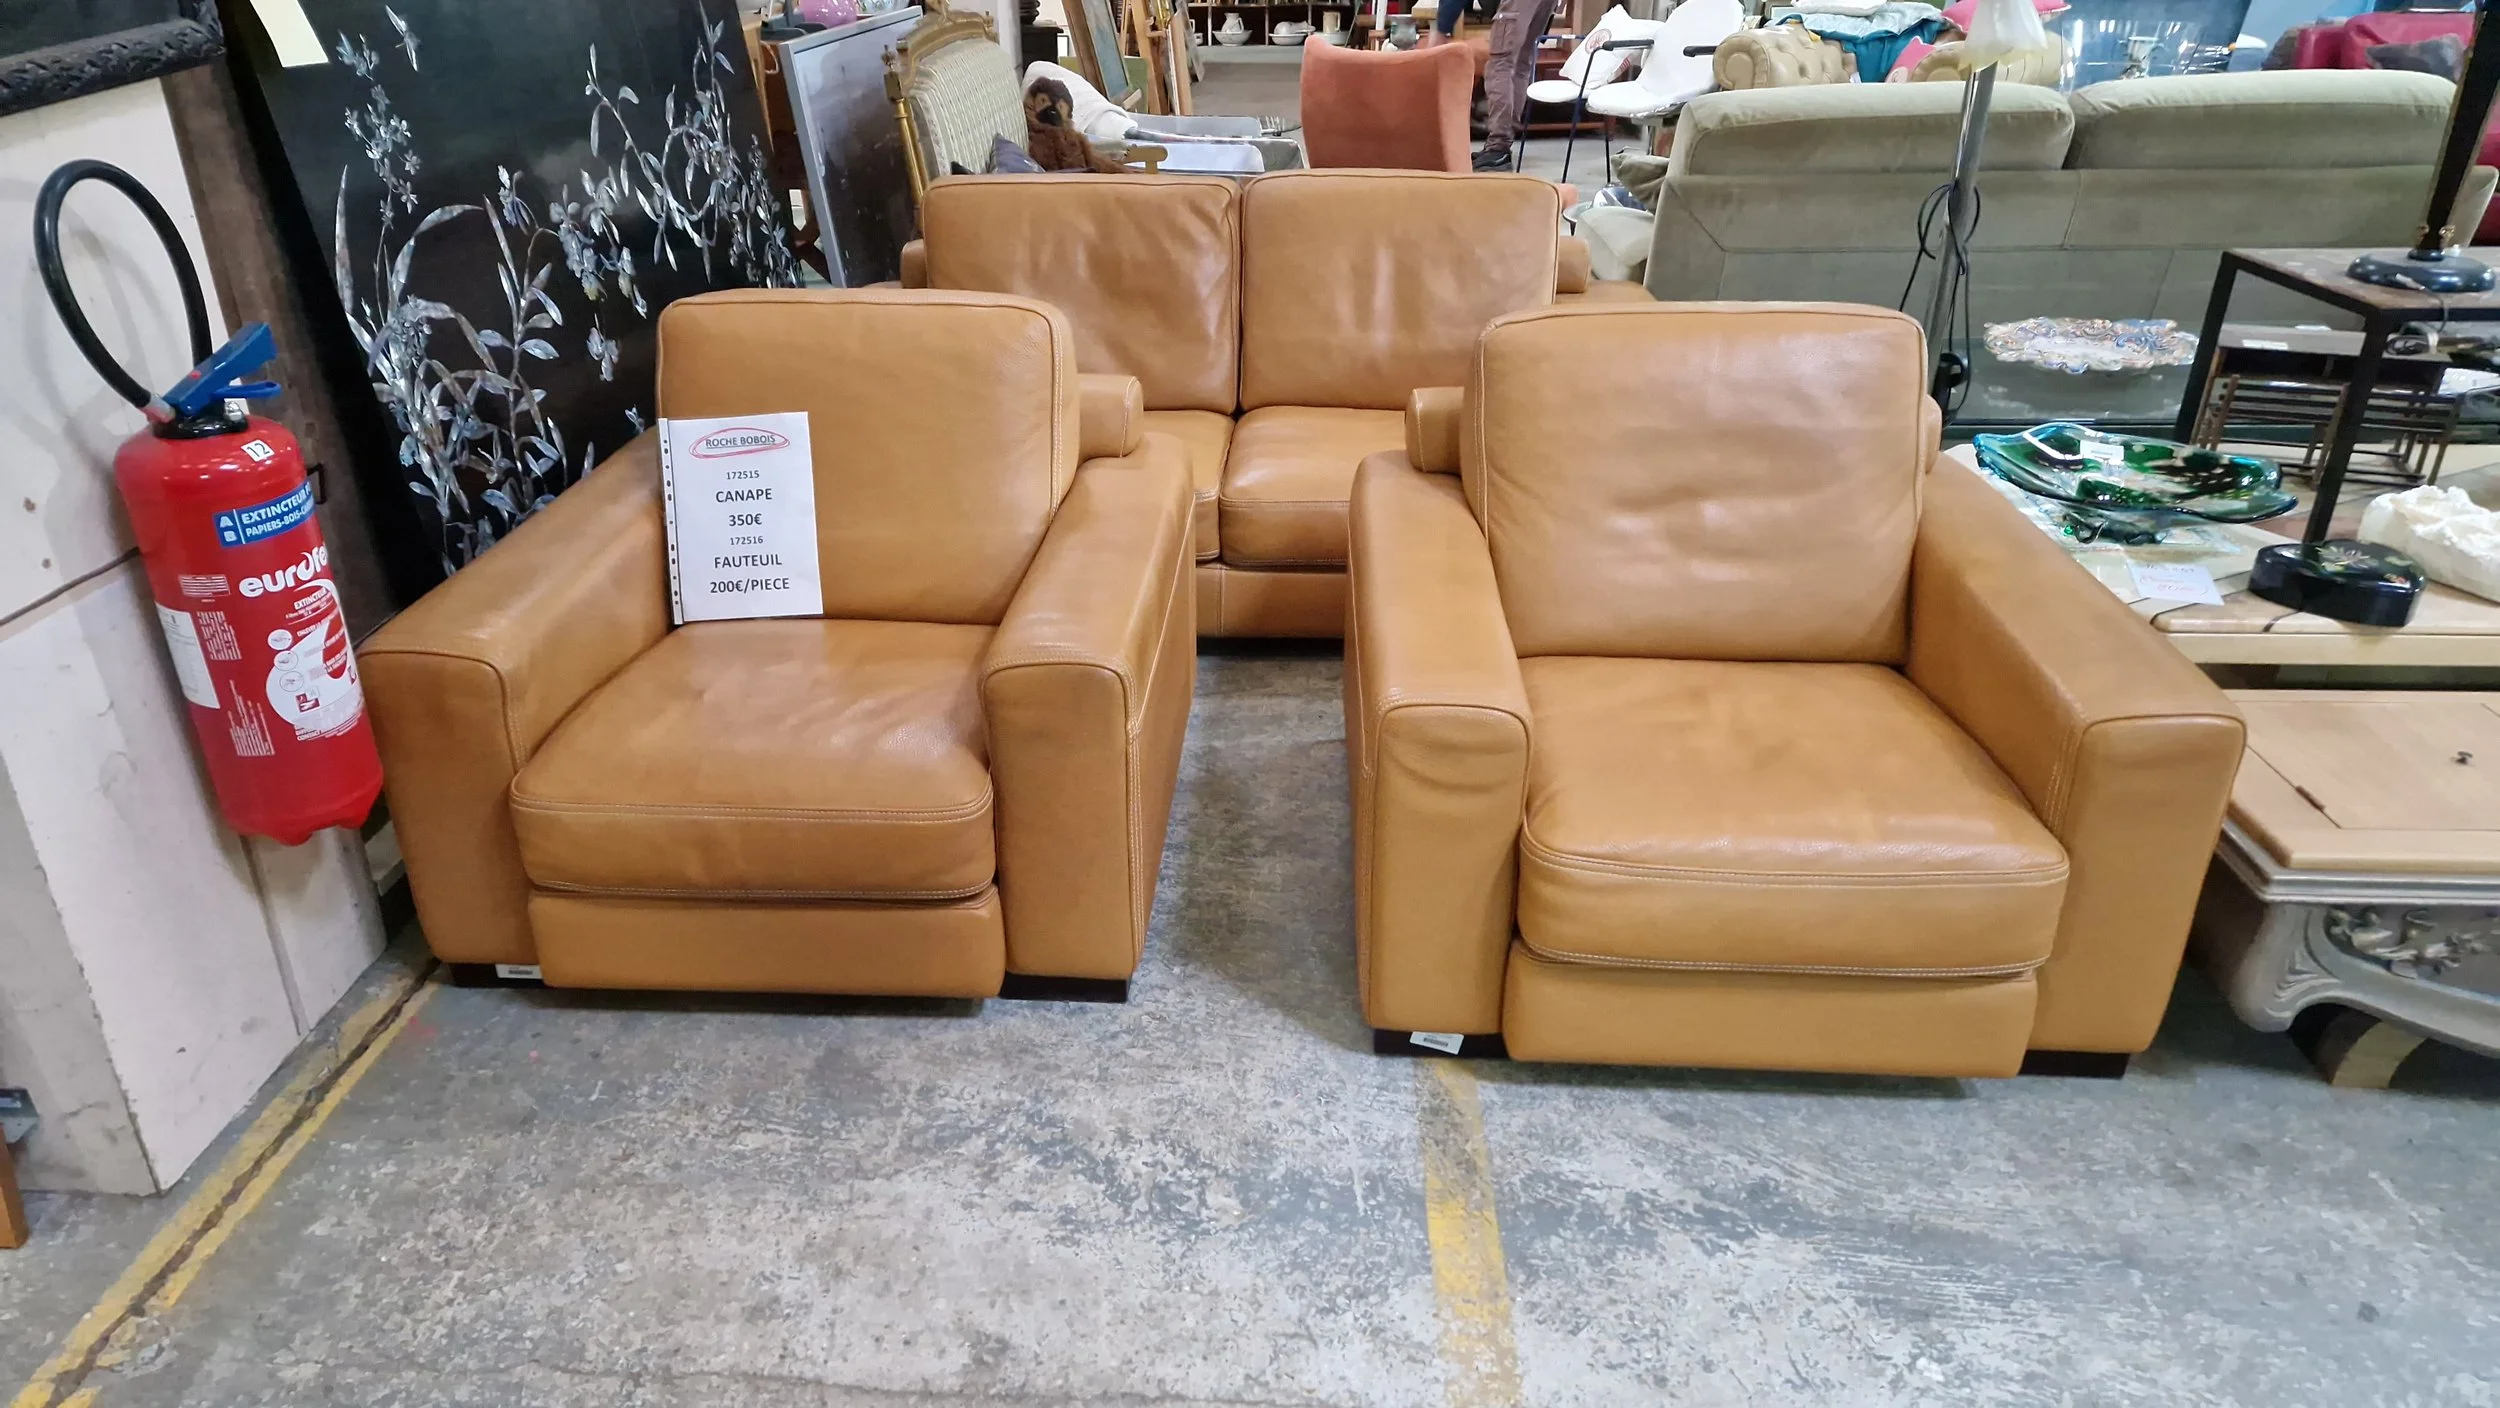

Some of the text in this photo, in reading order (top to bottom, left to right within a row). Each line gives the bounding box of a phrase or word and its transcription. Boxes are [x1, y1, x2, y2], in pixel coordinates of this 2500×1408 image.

[705, 434, 776, 448] ROCHE BOBOIS
[246, 442, 271, 458] 12
[726, 470, 760, 480] 172515
[715, 488, 773, 503] CANAPE
[220, 515, 234, 528] A
[728, 513, 763, 527] 350€
[223, 530, 237, 542] B
[730, 535, 764, 546] 172516
[714, 553, 782, 569] FAUTEUIL
[710, 577, 790, 594] 200€/PIECE
